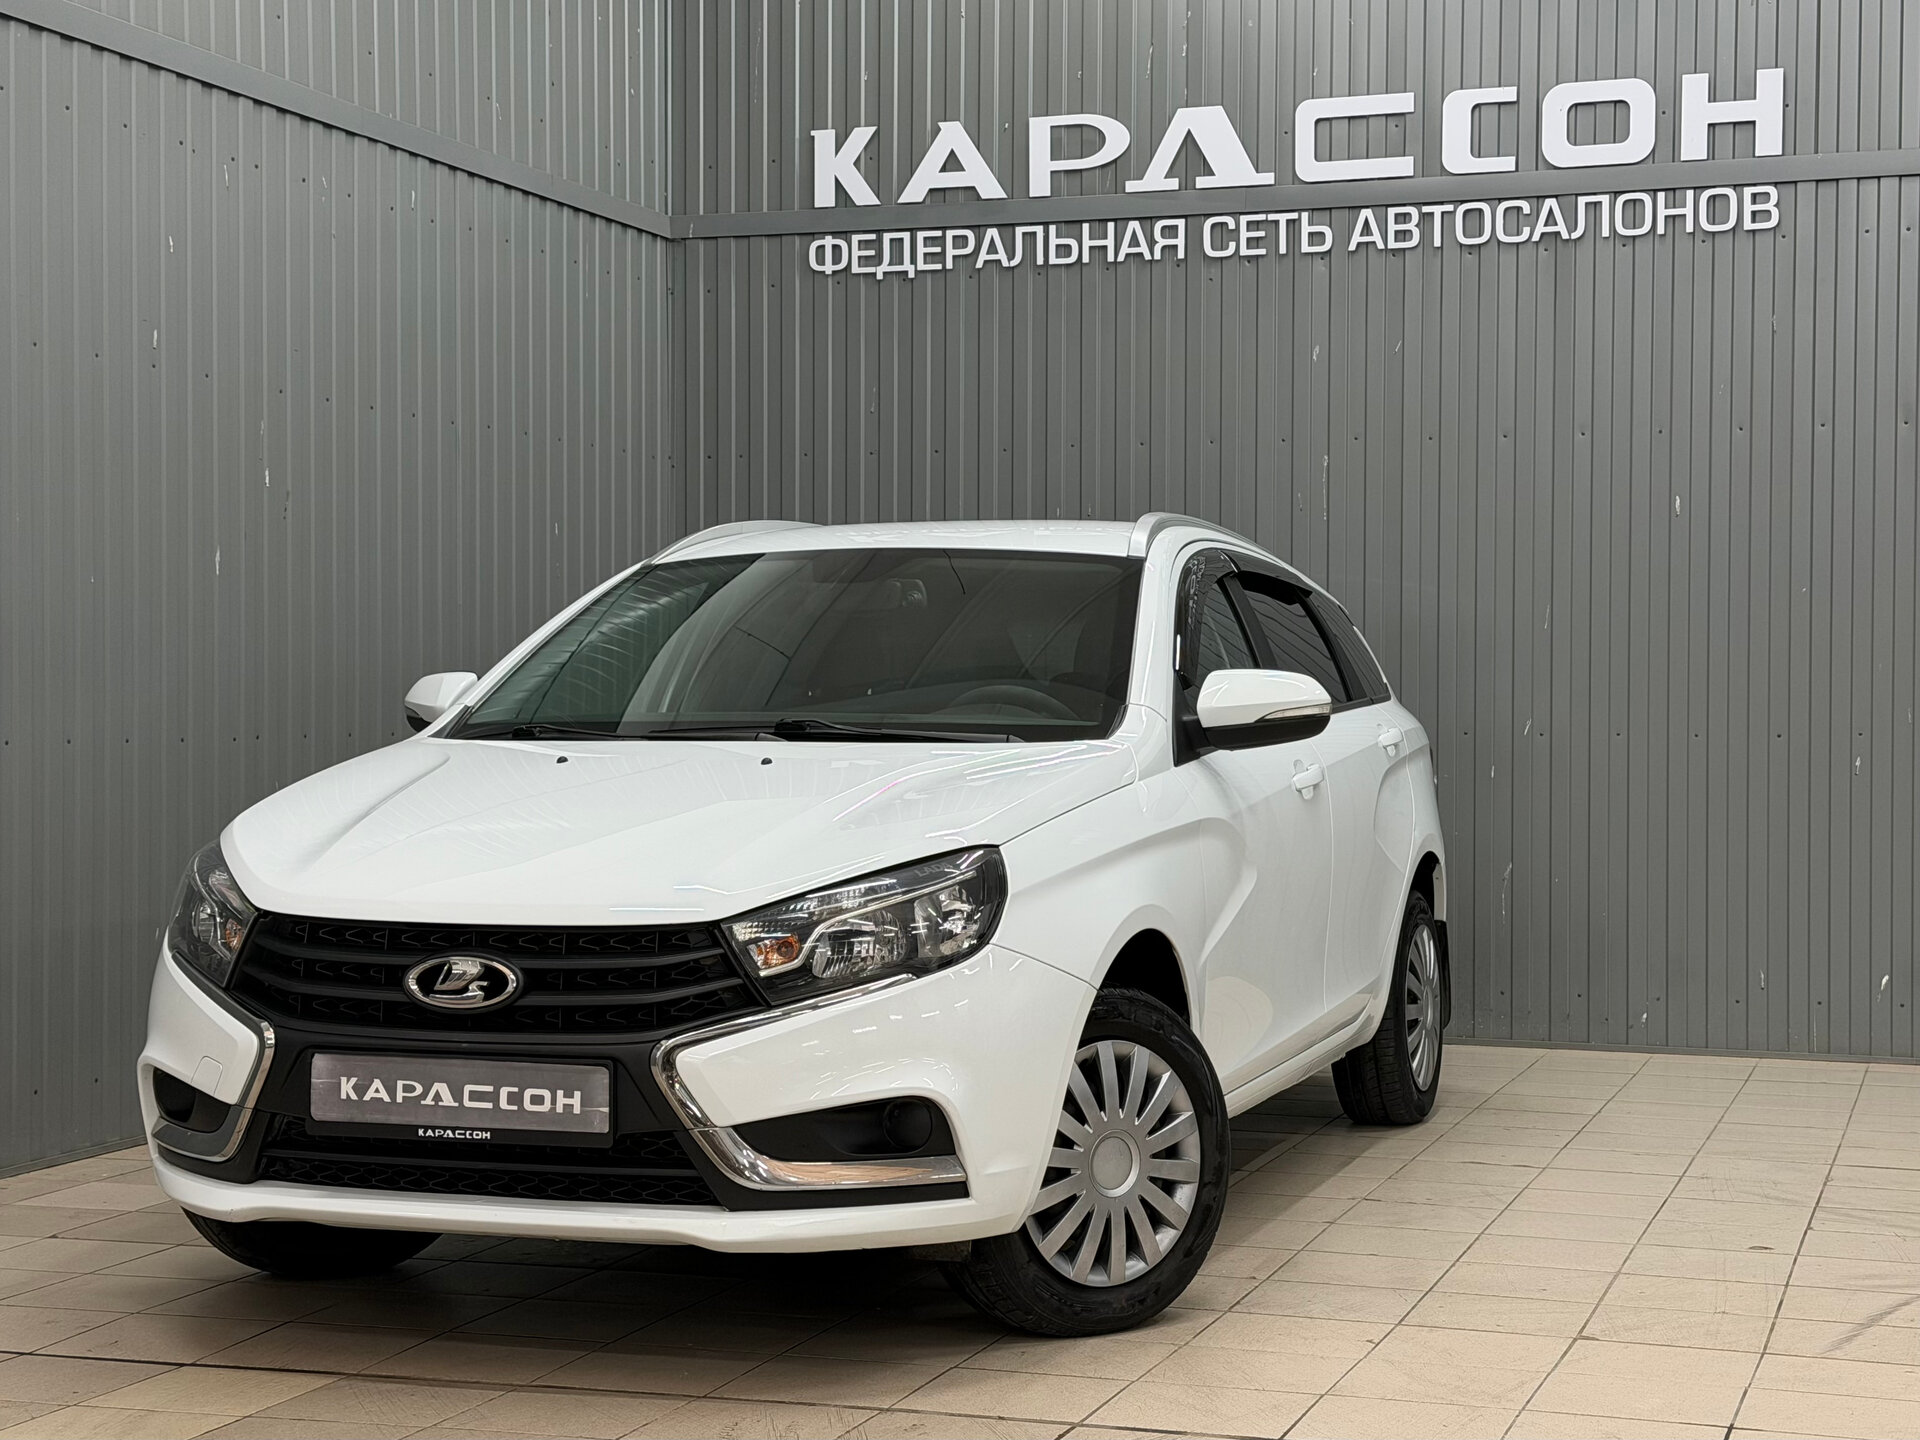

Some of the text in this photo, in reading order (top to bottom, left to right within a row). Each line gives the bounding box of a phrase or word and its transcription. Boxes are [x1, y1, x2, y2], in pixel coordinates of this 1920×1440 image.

[808, 185, 1780, 281] ФЕДЕРАЛЬНАЯ СЕТЬ АВТОСАЛОНОВ
